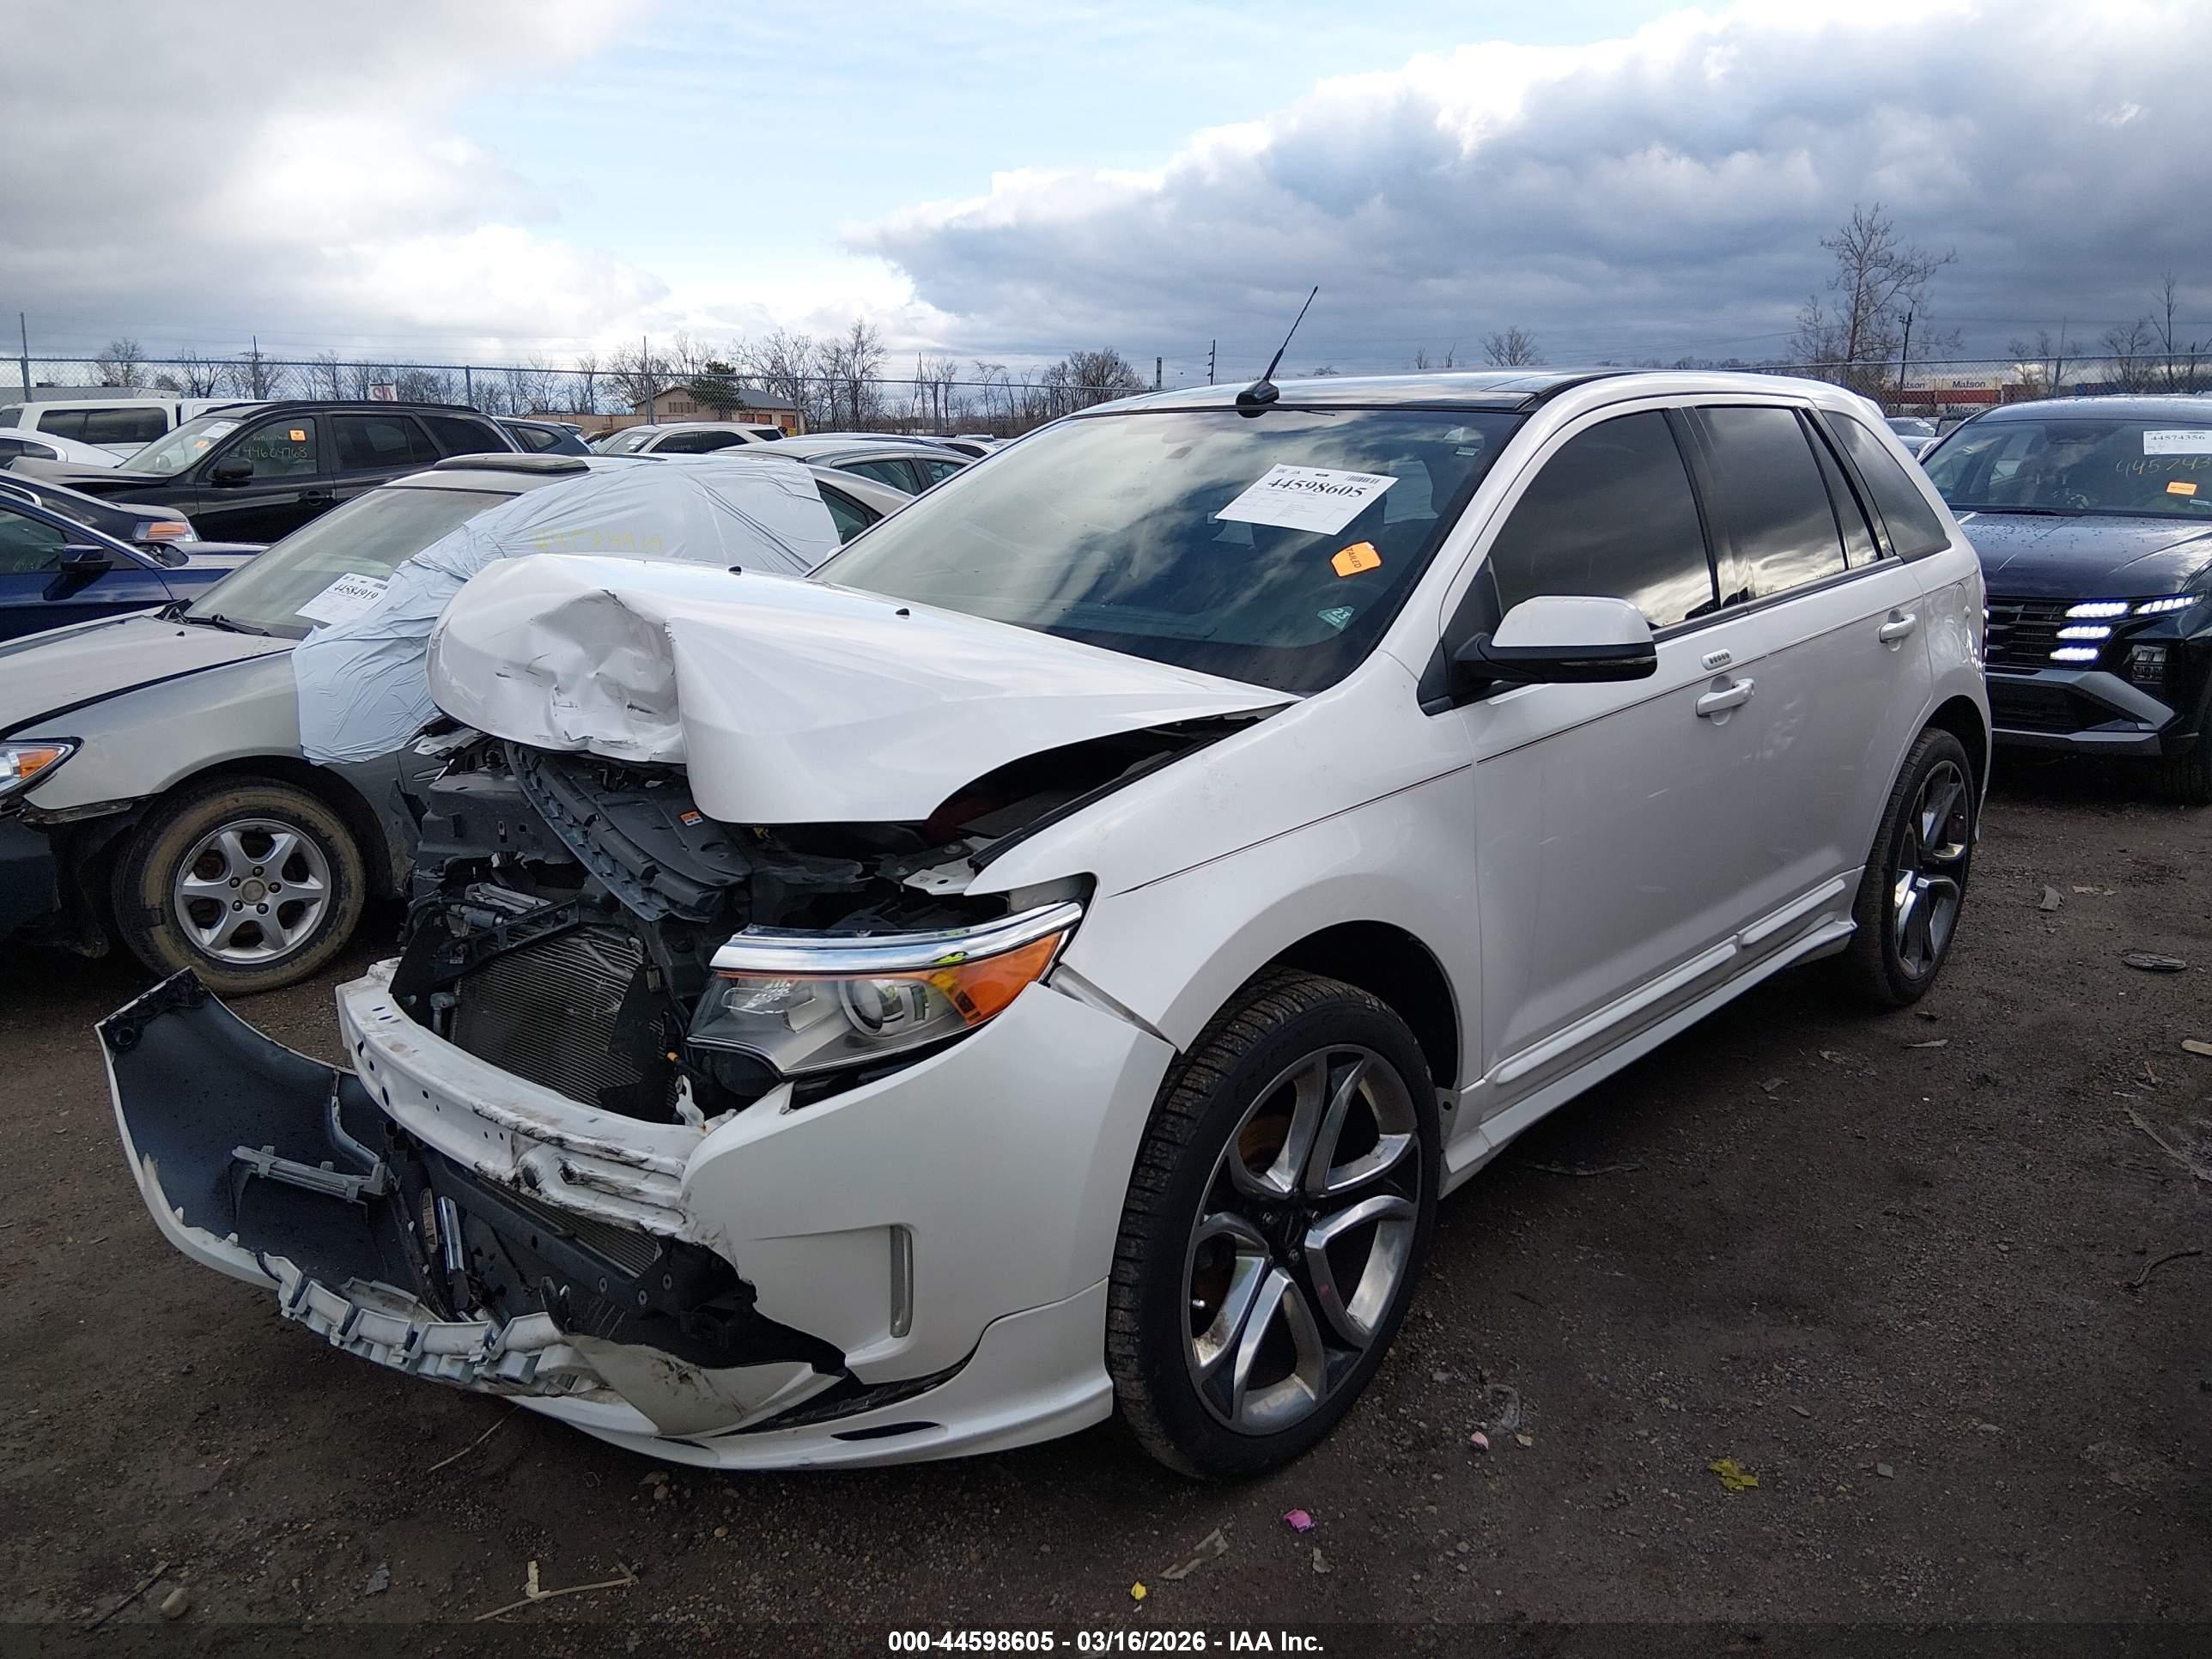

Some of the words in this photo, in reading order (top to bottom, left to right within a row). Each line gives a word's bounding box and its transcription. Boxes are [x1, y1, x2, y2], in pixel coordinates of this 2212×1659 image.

[1267, 477, 1368, 498] 44598605
[334, 583, 380, 600] 44584919
[1331, 607, 1351, 620] 23
